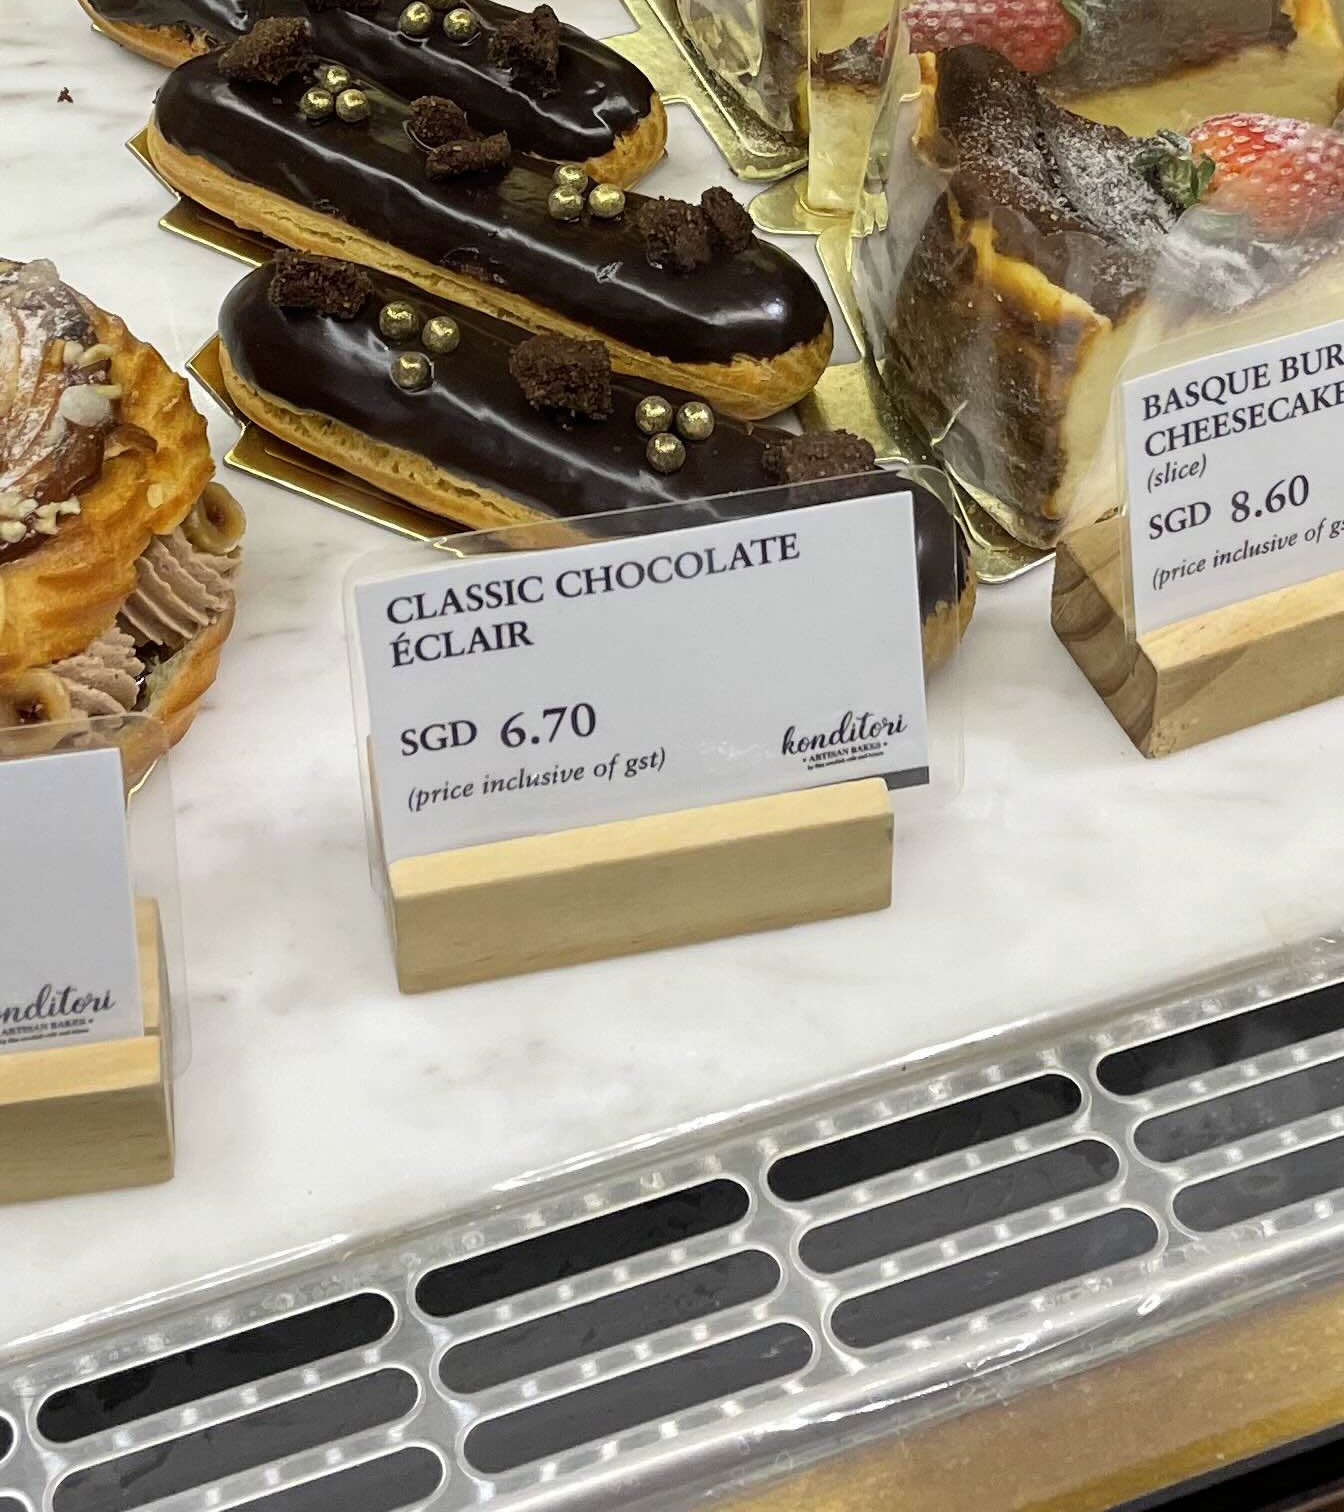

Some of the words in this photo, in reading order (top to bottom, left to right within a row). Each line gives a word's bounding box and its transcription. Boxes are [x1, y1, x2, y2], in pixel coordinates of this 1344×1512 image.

[1141, 364, 1272, 422] BASQUE
[1147, 454, 1208, 493] (slice)
[1148, 500, 1212, 540] SGD
[1230, 473, 1311, 524] 8.60
[386, 575, 546, 625] CLASSIC
[555, 532, 802, 600] CHOCOLATE
[1152, 558, 1206, 591] (price
[1213, 531, 1299, 568] inclusive
[1303, 518, 1326, 545] of
[390, 619, 535, 668] ÉCLAIR
[399, 720, 478, 756] SGD
[500, 702, 598, 749] 6.70
[782, 710, 908, 755] konditori
[809, 748, 850, 762] ARTISAN
[407, 782, 476, 812] (price
[482, 765, 587, 796] inclusive
[593, 753, 620, 780] of
[623, 747, 667, 779] gst)
